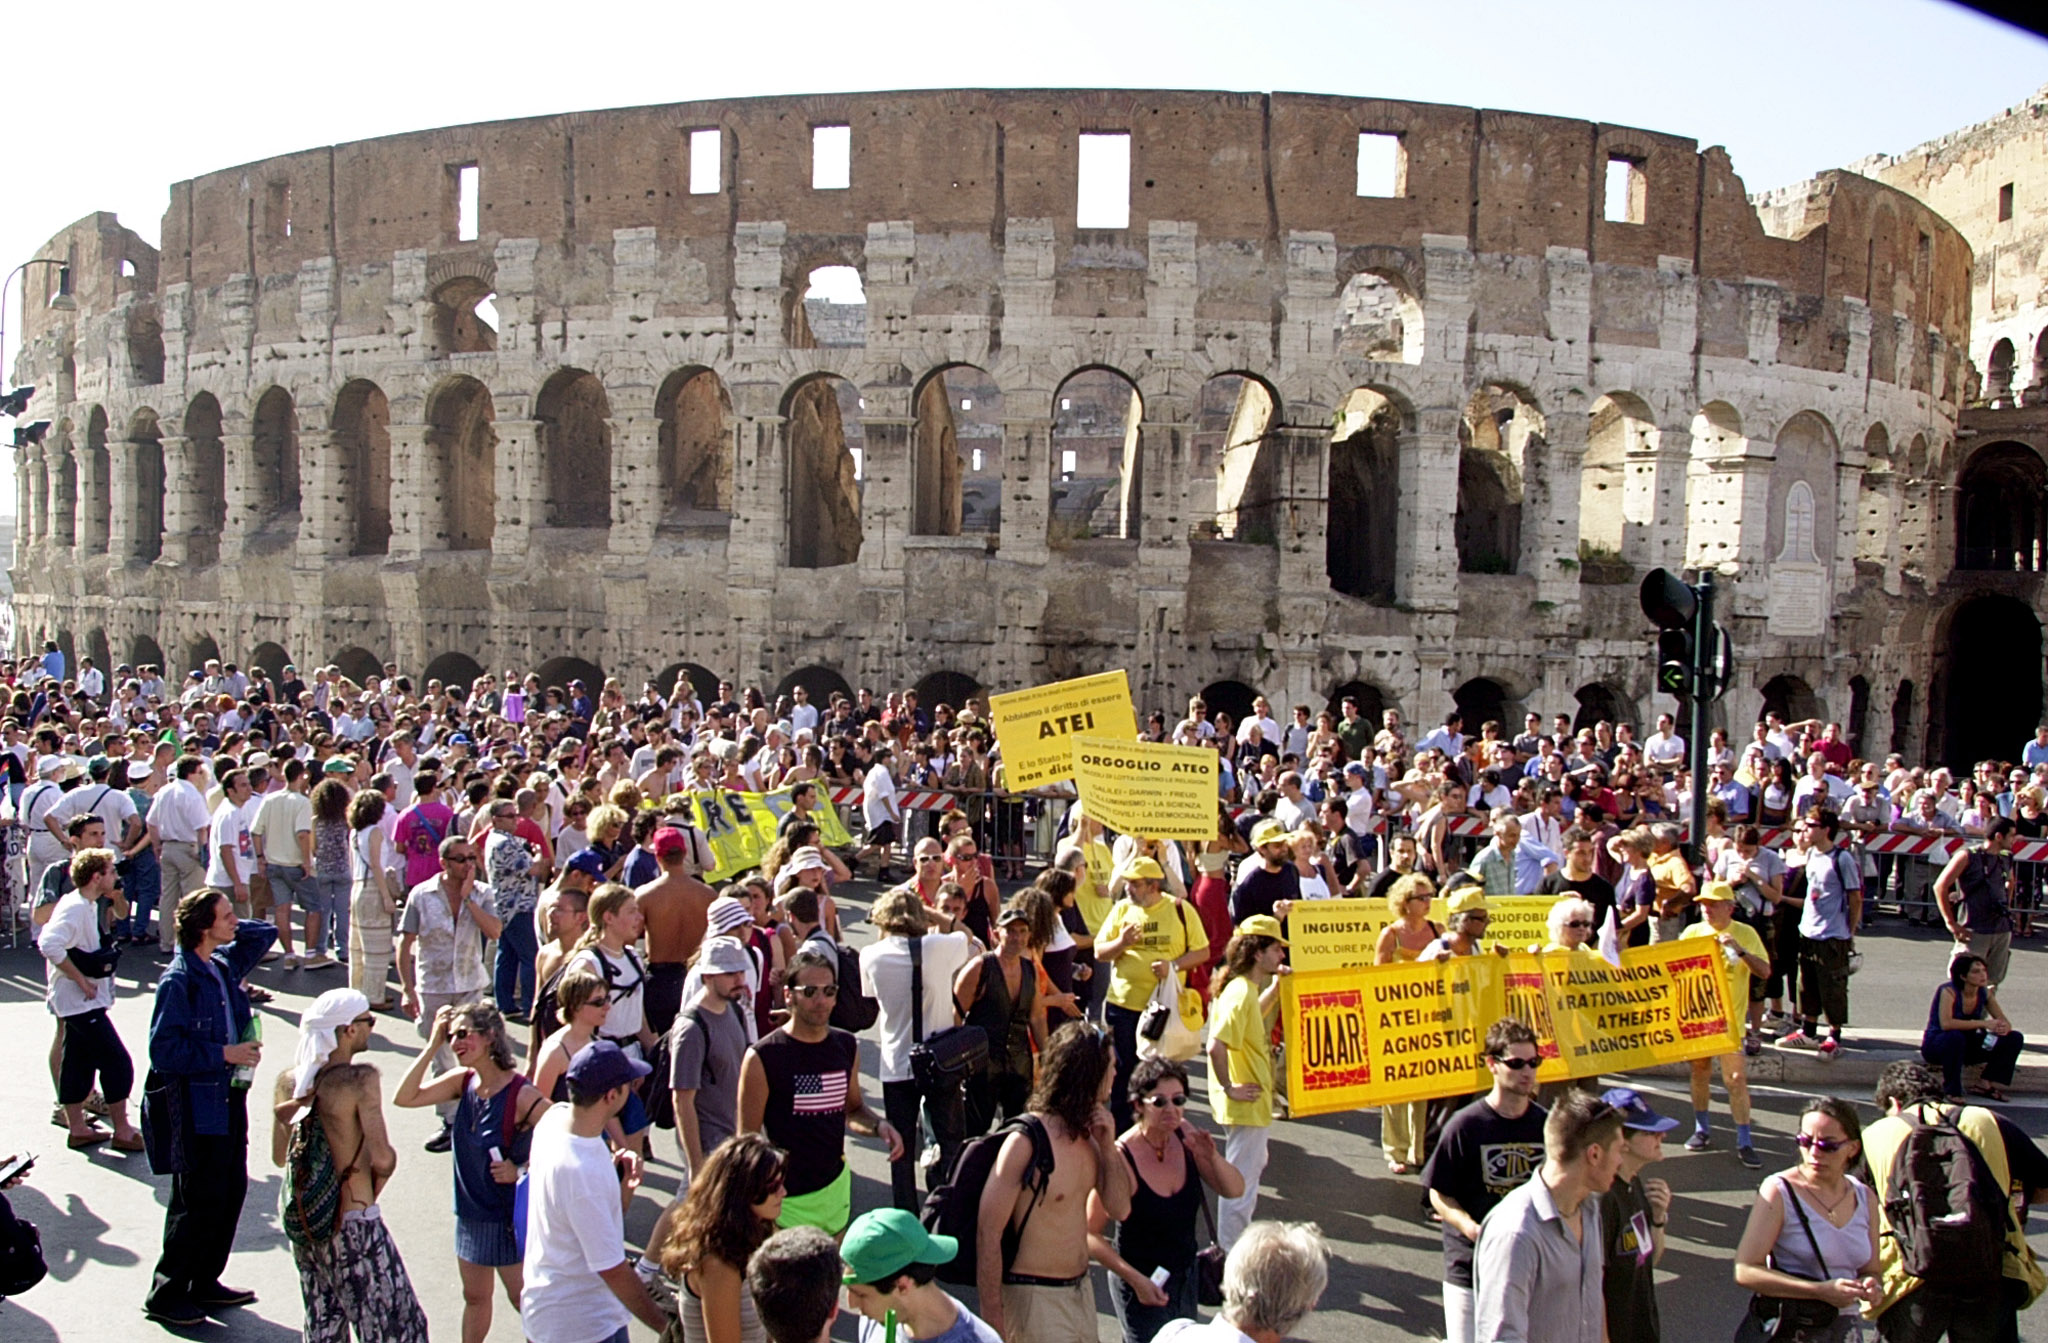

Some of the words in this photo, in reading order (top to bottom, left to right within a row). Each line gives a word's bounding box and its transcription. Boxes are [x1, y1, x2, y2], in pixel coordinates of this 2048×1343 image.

[1003, 708, 1042, 722] Abbiamo
[1051, 701, 1078, 713] diritto
[1080, 698, 1089, 707] di
[1091, 693, 1121, 705] essere
[1039, 711, 1094, 740] ATEI
[1037, 755, 1061, 766] Stato
[1081, 755, 1161, 771] ORGOGLIO
[1172, 763, 1209, 774] ATEO
[1018, 771, 1042, 782] non
[1092, 784, 1122, 795] GALILEI
[1129, 789, 1162, 797] DARWIN
[1169, 791, 1197, 799] FREUD
[1112, 810, 1135, 818] CIVILI
[1155, 811, 1209, 820] DEMOCRAZIA
[1166, 801, 1201, 809] SCIENZA
[1303, 922, 1371, 934] INGIUSTA
[1486, 930, 1543, 939] MOFOBIA
[1302, 944, 1332, 954] VUOL
[1334, 944, 1359, 953] DIRE
[1551, 970, 1608, 987] ITALIAN
[1612, 963, 1663, 983] UNION
[1375, 979, 1446, 1002] UNIONE
[1566, 985, 1670, 1010] RATIONALIST
[1680, 974, 1720, 1021] UAAR
[1380, 1009, 1421, 1028] ATEI
[1597, 1007, 1671, 1030] ATHEISTS
[1306, 1013, 1363, 1067] UAAR
[1382, 1028, 1477, 1055] AGNOSTICI
[1590, 1029, 1674, 1055] AGNOSTICS
[1384, 1052, 1486, 1082] RAZIONALIS
